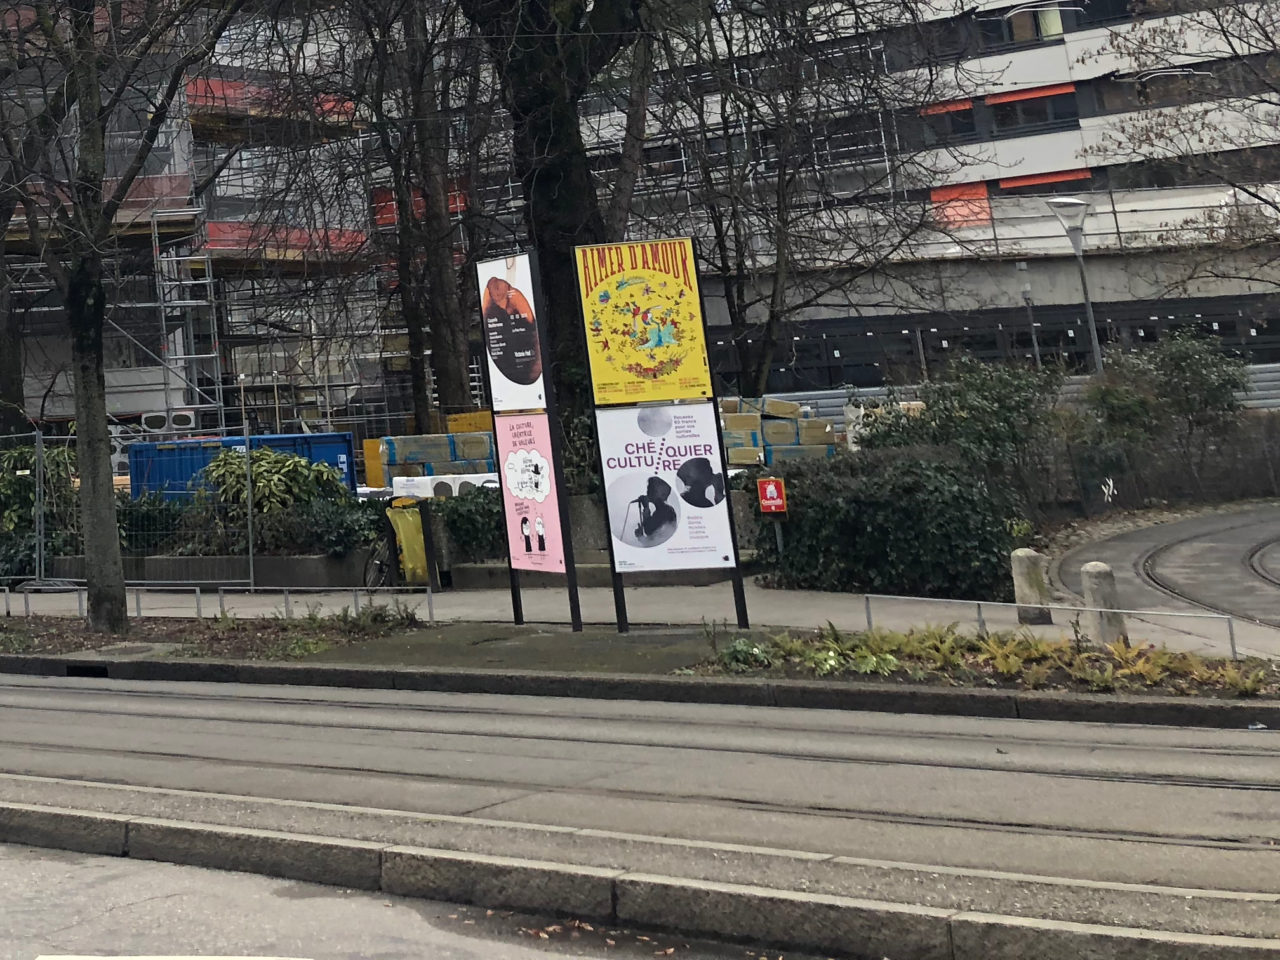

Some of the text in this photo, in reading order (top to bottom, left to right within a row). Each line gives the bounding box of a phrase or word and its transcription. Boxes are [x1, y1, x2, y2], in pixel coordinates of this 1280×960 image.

[581, 241, 693, 299] AIMER D'AMOUR
[625, 439, 713, 458] CHÉ QUIER
[606, 455, 681, 471] CULTU RE
